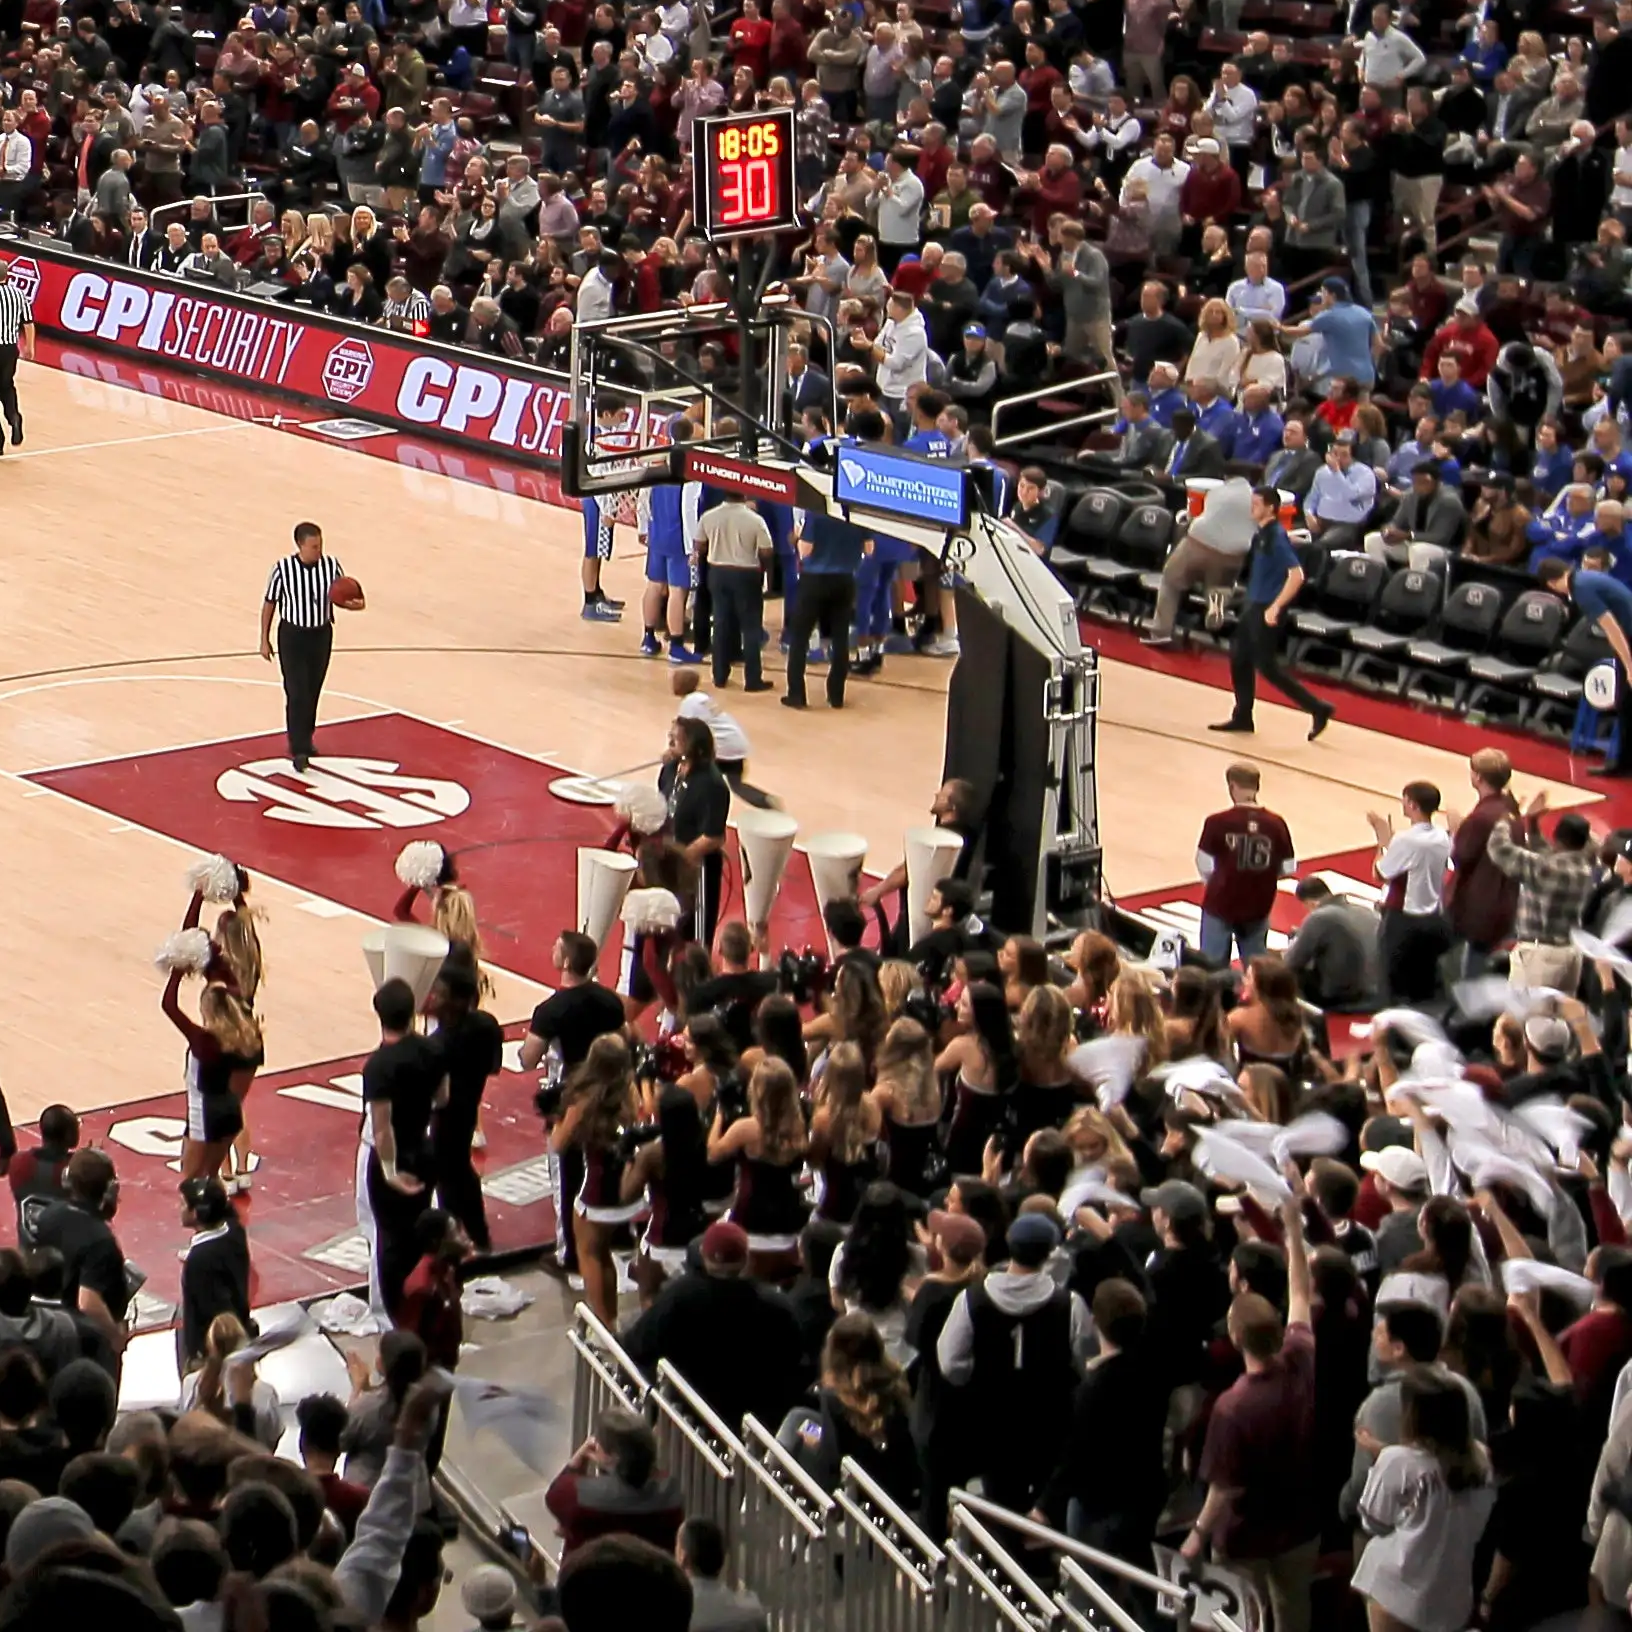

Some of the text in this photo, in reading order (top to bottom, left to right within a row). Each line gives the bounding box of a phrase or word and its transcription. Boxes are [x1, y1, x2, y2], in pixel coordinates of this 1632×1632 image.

[719, 123, 779, 160] 18:05
[722, 160, 774, 223] 30
[61, 272, 305, 384] CPI SECURITY
[328, 357, 369, 383] CPI
[397, 356, 533, 446] CPI
[706, 464, 787, 493] UNDER ARMOUR
